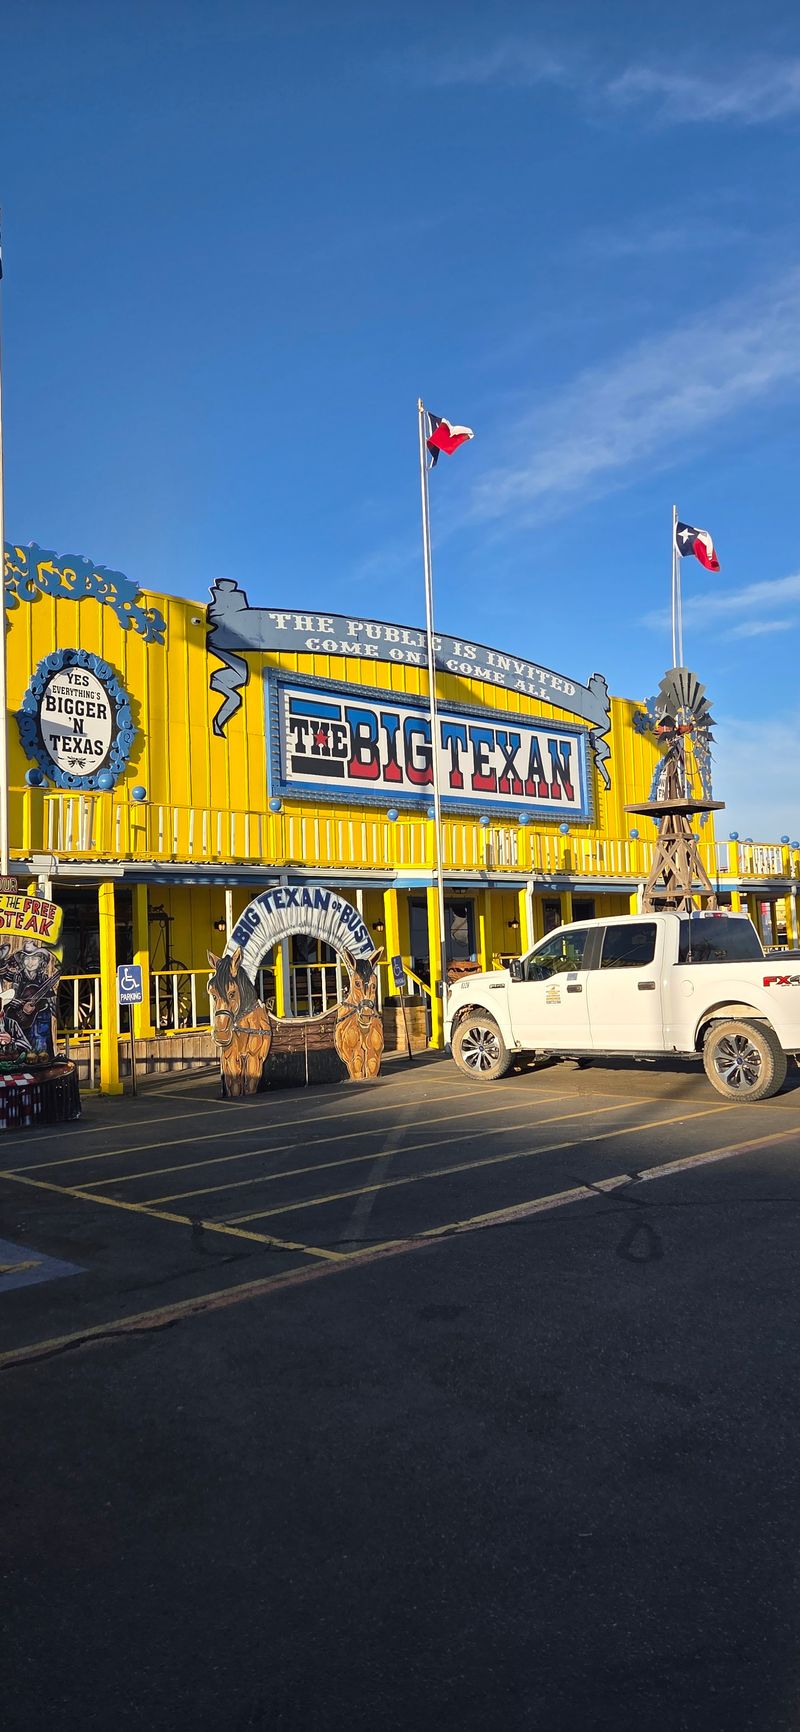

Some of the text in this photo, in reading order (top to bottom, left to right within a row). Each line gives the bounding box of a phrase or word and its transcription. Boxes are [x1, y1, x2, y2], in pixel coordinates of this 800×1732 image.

[269, 613, 577, 696] THE PUBLIC IS INVITED
[66, 673, 89, 687] YES
[305, 638, 379, 657] COME
[446, 659, 505, 685] COME
[514, 679, 550, 700] ALL
[52, 685, 101, 700] EVERYTHING'S
[45, 695, 107, 720] BIGGER
[69, 717, 84, 735] 'N
[49, 734, 104, 757] TEXAS
[290, 706, 575, 802] THE BIG TEXAN
[6, 896, 56, 920] THE FREE
[231, 887, 375, 954] BIG TEXAN OR BUST
[120, 992, 141, 1001] PARKING
